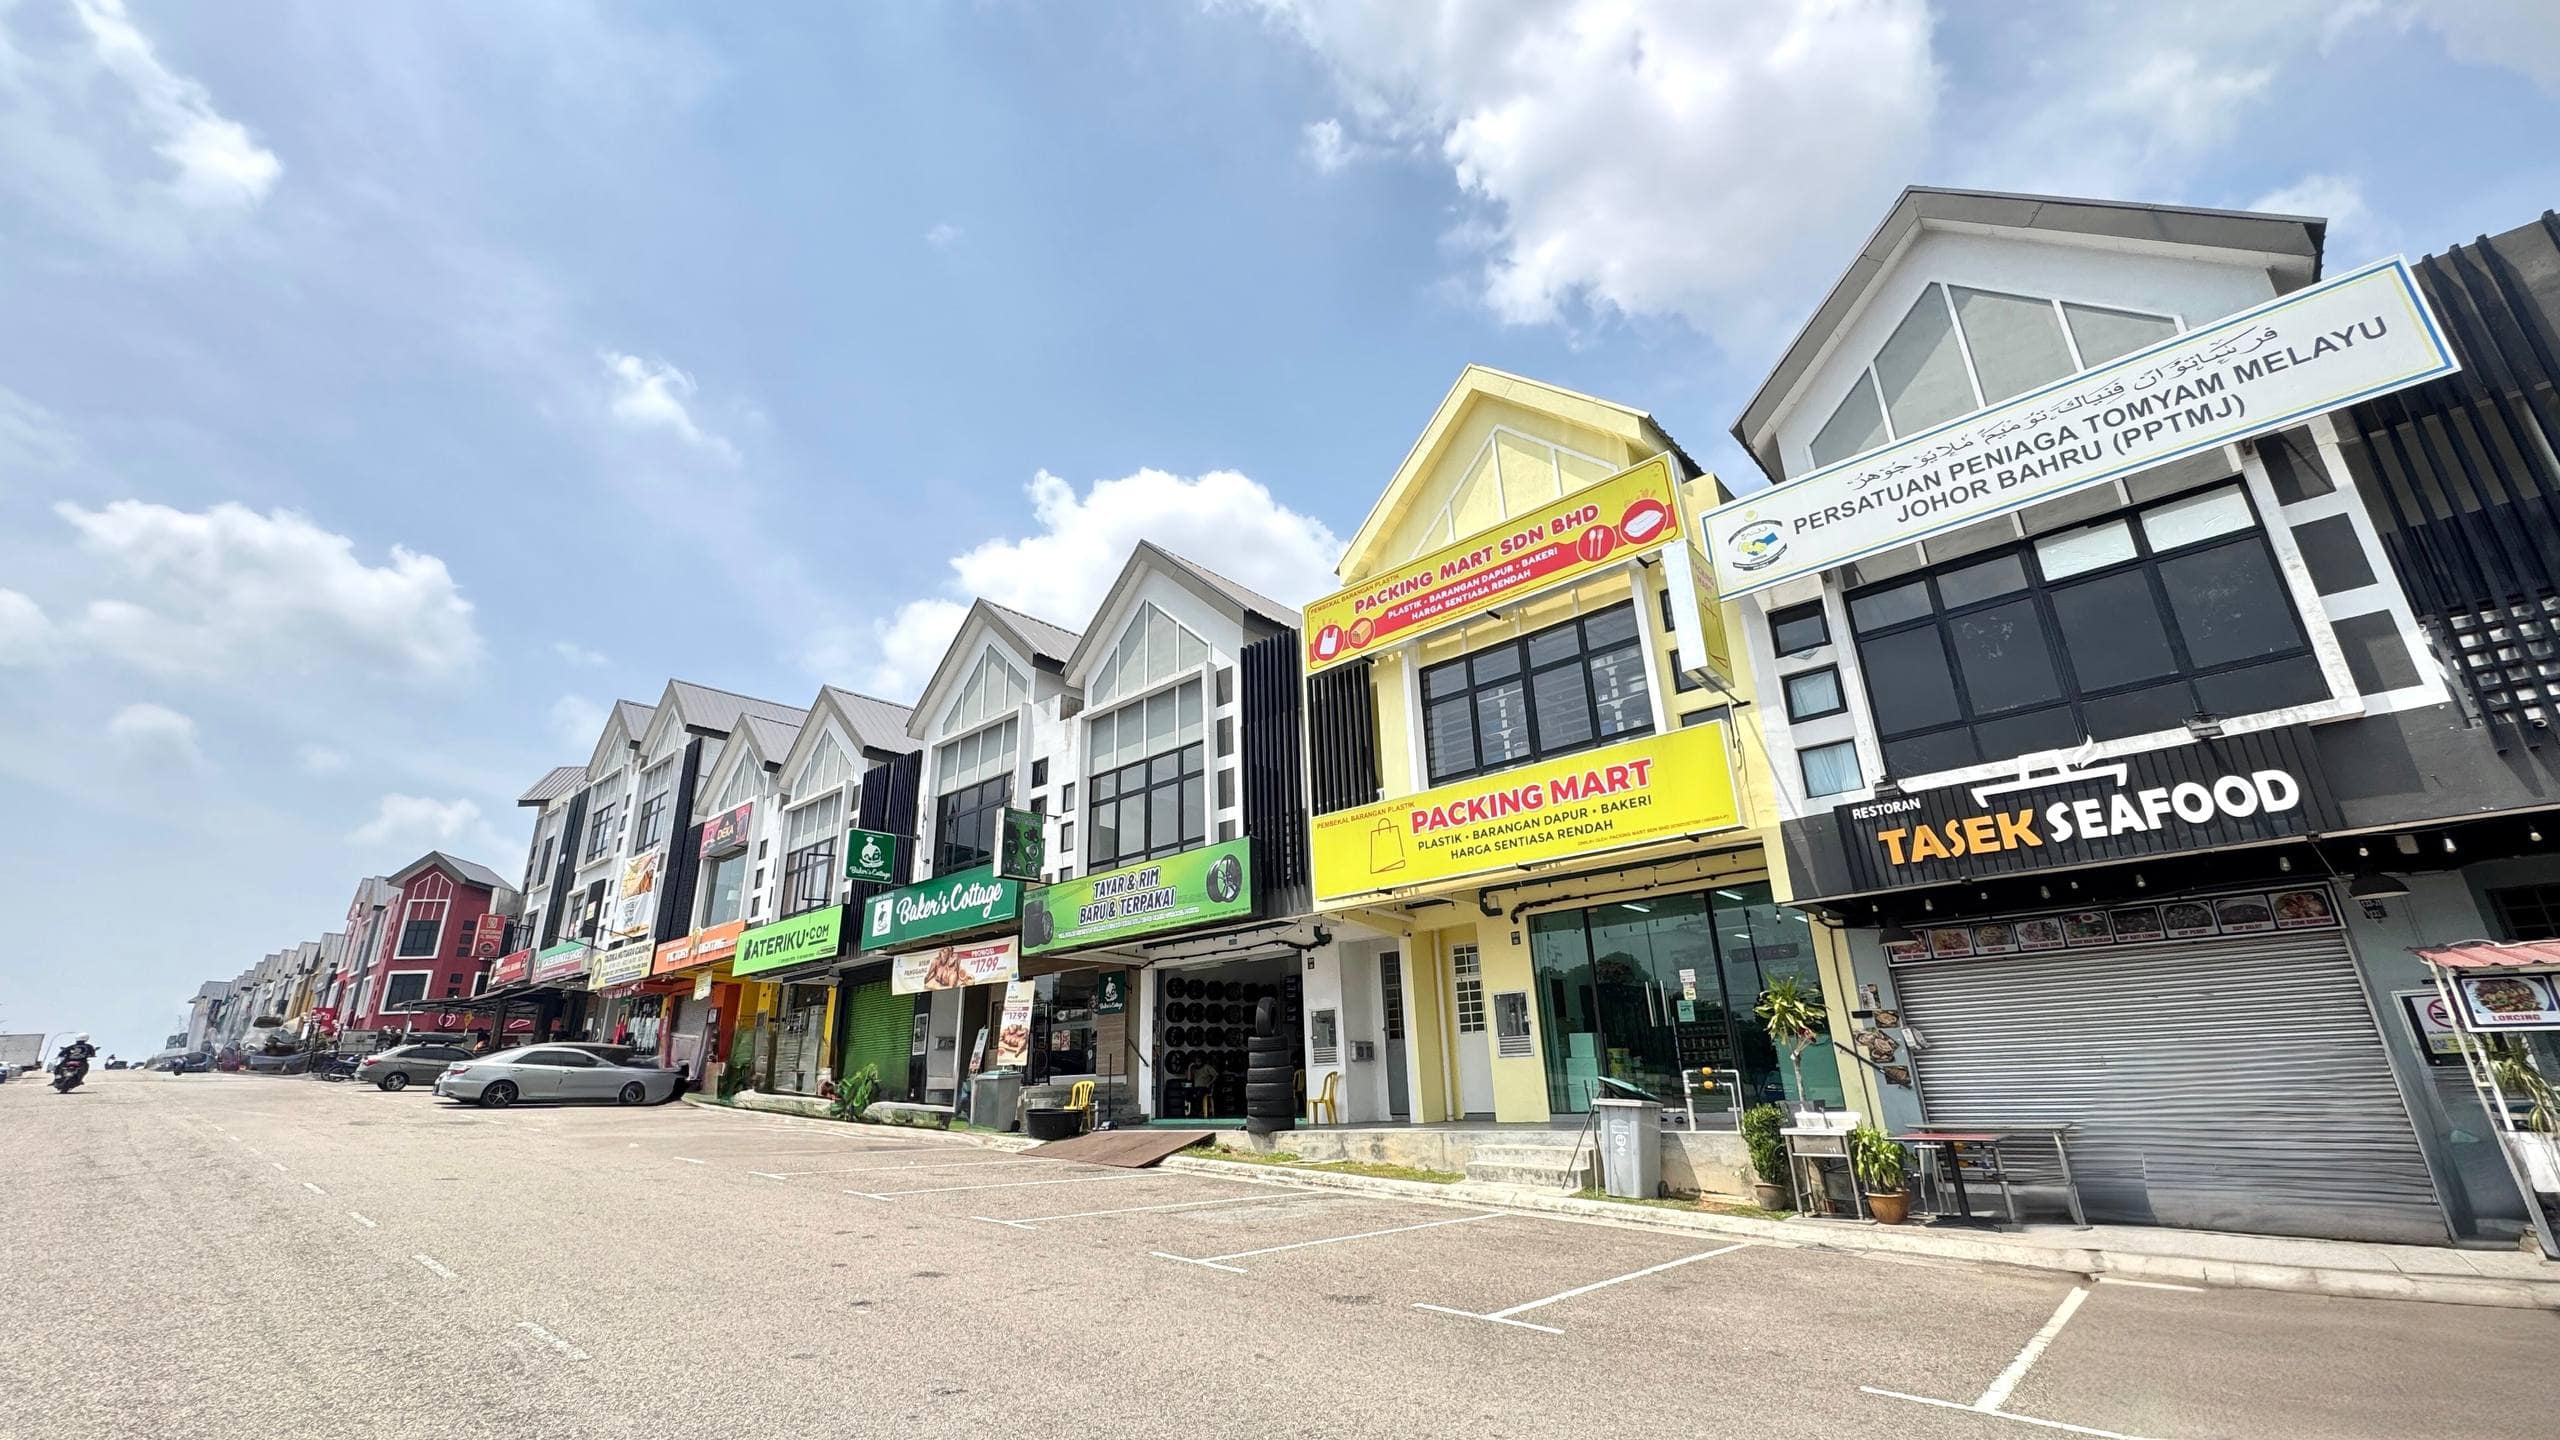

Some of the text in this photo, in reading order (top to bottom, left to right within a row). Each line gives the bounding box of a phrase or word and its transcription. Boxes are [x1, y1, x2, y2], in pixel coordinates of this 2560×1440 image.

[1794, 470, 1942, 535] PERSATUAN
[1950, 424, 2078, 483] PENIAGA
[2084, 372, 2225, 436] TOMYAM
[2233, 316, 2388, 384] MELAYU
[1896, 393, 2246, 524] JOHOR BAHRU (PPTMJ)
[1354, 571, 1433, 615] PACKING
[1440, 546, 1493, 581] MART
[1500, 526, 1544, 556] SDN
[1550, 504, 1600, 536] BHD
[1374, 573, 1400, 588] PLASTIK
[1388, 599, 1423, 620] PLASTIK
[1429, 577, 1480, 604] BARANGAN
[1482, 564, 1514, 584] DAPUR
[1521, 547, 1558, 567] BAKERI
[1411, 602, 1443, 621] HARGA
[1445, 586, 1490, 609] SENTIASA
[1491, 569, 1531, 592] RENDAH
[1350, 808, 1386, 822] BARANGAN
[1387, 801, 1415, 813] PLASTIK
[1411, 759, 1652, 834] PACKING MART
[1417, 794, 1652, 851] PLASTIK BARANGAN DAPUR BAKERI
[1852, 798, 1921, 820] RESTORAN
[1878, 769, 2301, 866] TASEK SEAFOOD
[1450, 819, 1614, 860] HARGA SENTIASA RENDAH
[896, 880, 1004, 925] Baker's Cottage
[1079, 901, 1106, 925] BARU
[1107, 900, 1116, 918] &
[1119, 886, 1177, 917] TERPAKAI
[1093, 866, 1161, 898] TAYAR & RIM
